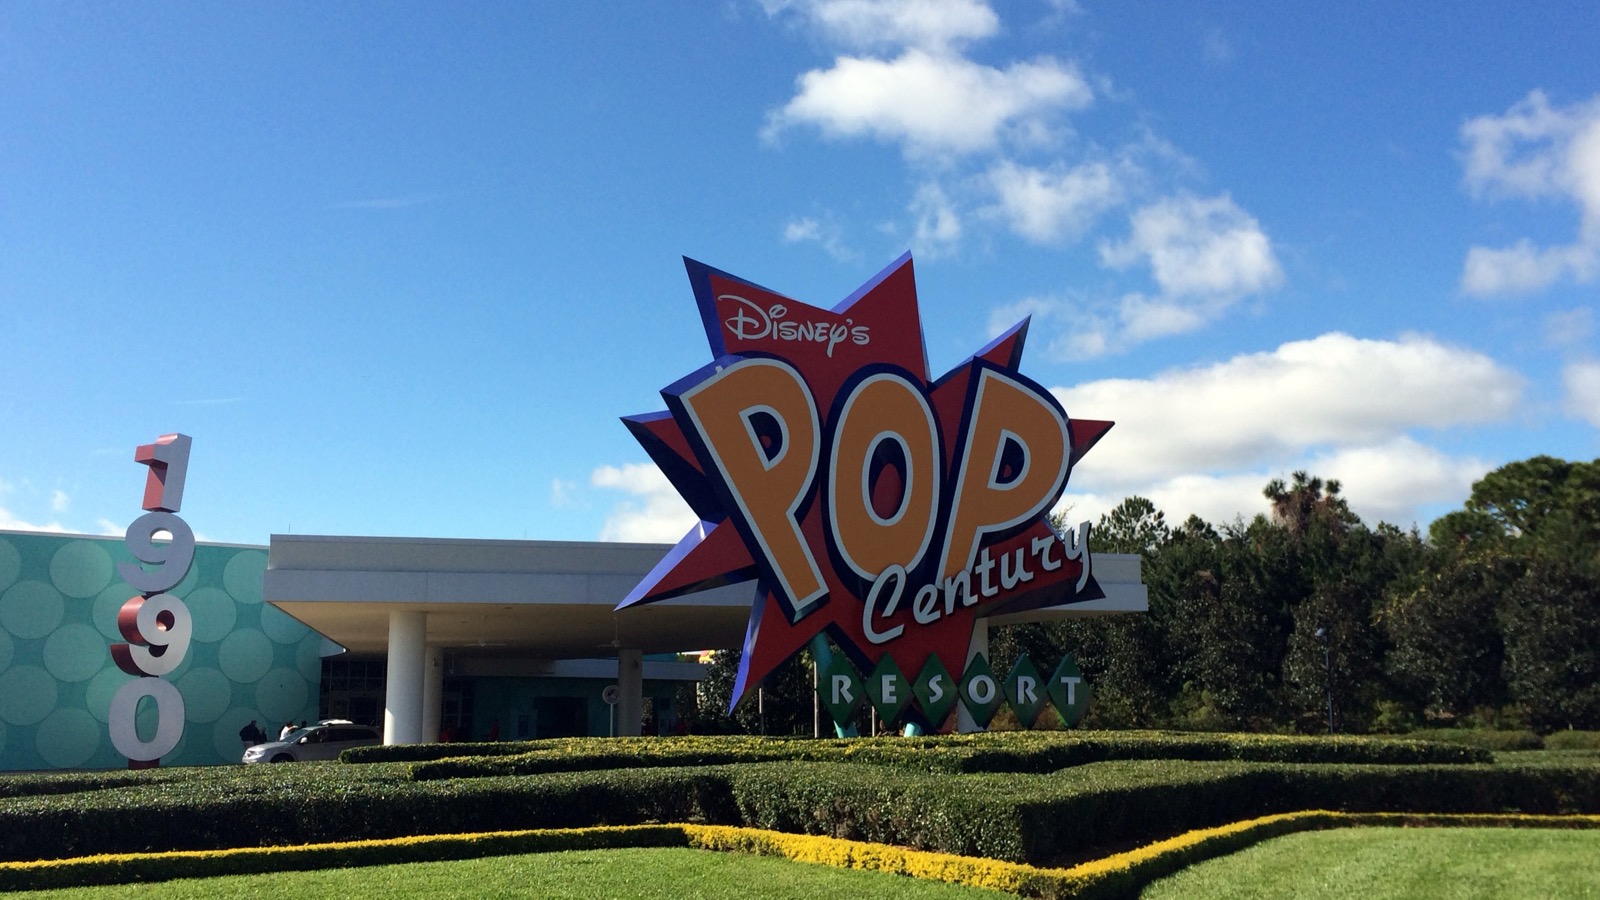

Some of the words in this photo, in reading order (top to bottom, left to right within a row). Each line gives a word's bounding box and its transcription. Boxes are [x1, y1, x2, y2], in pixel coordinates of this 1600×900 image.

[678, 357, 1071, 611] POP
[108, 433, 195, 761] 1990
[863, 520, 1092, 645] Century
[832, 674, 1082, 705] RESORT
